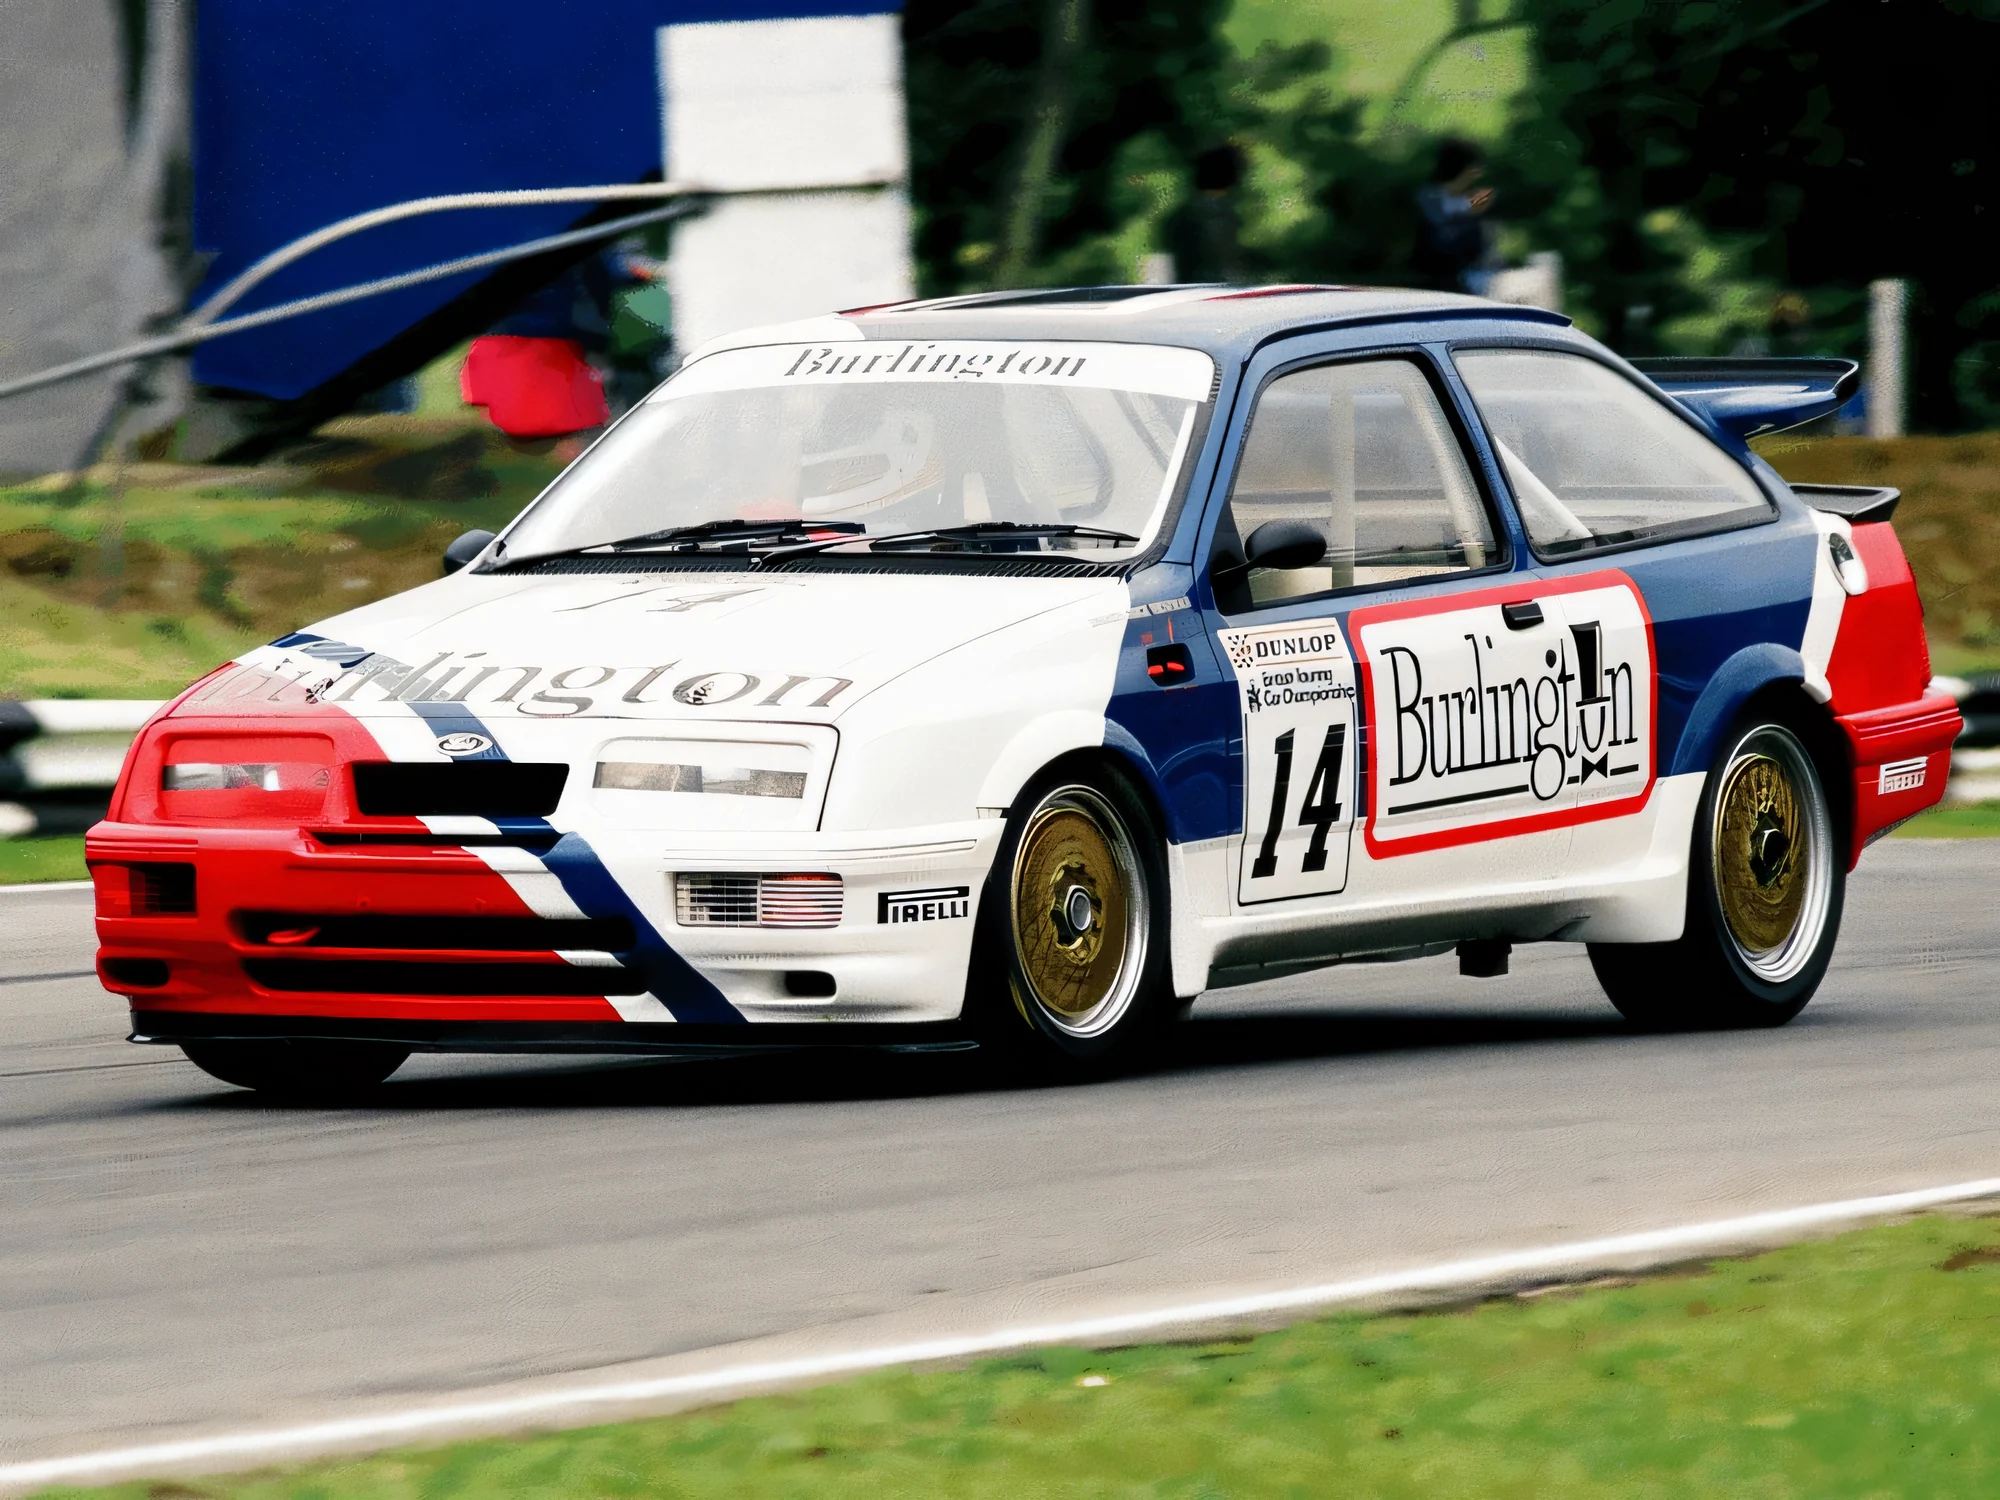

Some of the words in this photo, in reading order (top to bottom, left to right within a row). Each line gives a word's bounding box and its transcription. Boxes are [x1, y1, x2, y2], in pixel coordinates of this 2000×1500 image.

[784, 345, 1086, 379] Burlington
[1255, 633, 1336, 658] DUNLOP
[1252, 724, 1346, 878] 14
[877, 886, 970, 924] PIRELLI
